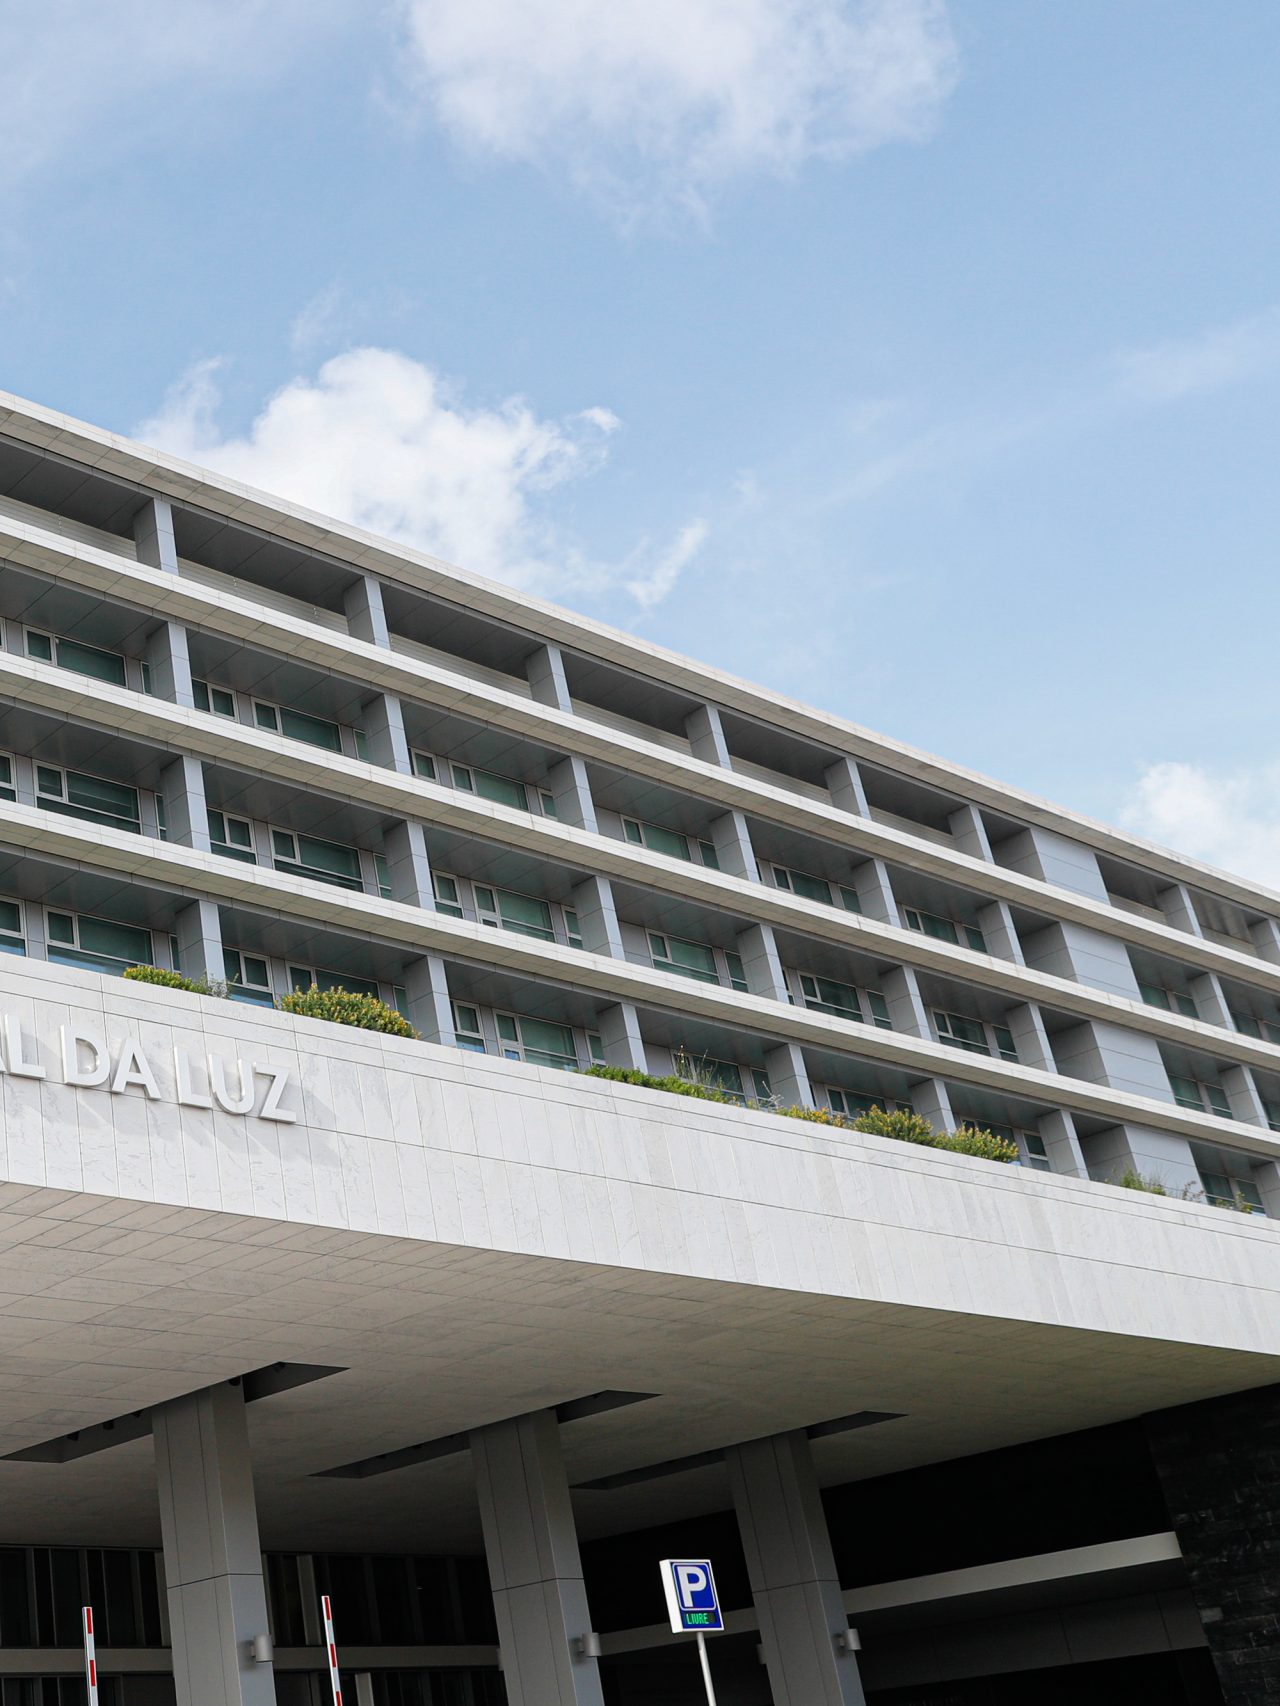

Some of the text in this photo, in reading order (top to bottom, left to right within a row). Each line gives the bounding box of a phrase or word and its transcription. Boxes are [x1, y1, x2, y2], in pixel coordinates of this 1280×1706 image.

[60, 1024, 161, 1100] DA
[174, 1047, 297, 1124] LUZ
[677, 1566, 707, 1607] P
